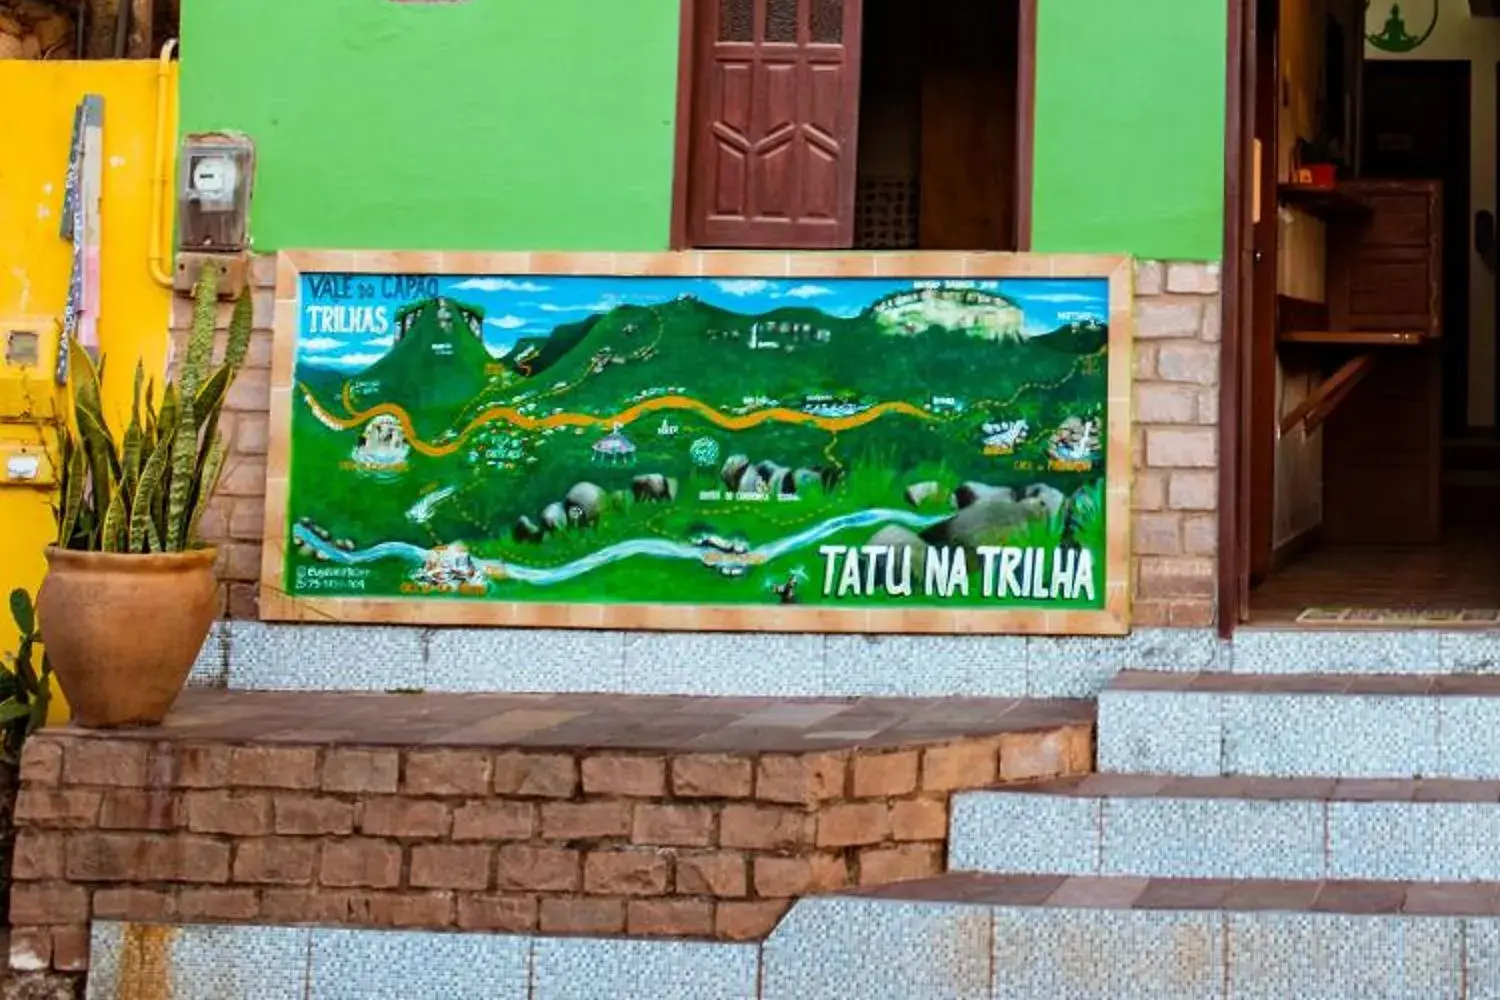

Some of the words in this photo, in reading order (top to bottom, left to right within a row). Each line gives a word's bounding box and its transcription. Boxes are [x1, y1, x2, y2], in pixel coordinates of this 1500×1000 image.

[308, 275, 353, 299] VALE
[306, 305, 389, 334] TRILHAS
[819, 545, 912, 596] TATU
[925, 546, 969, 597] NA
[976, 546, 1095, 600] TRILHA
